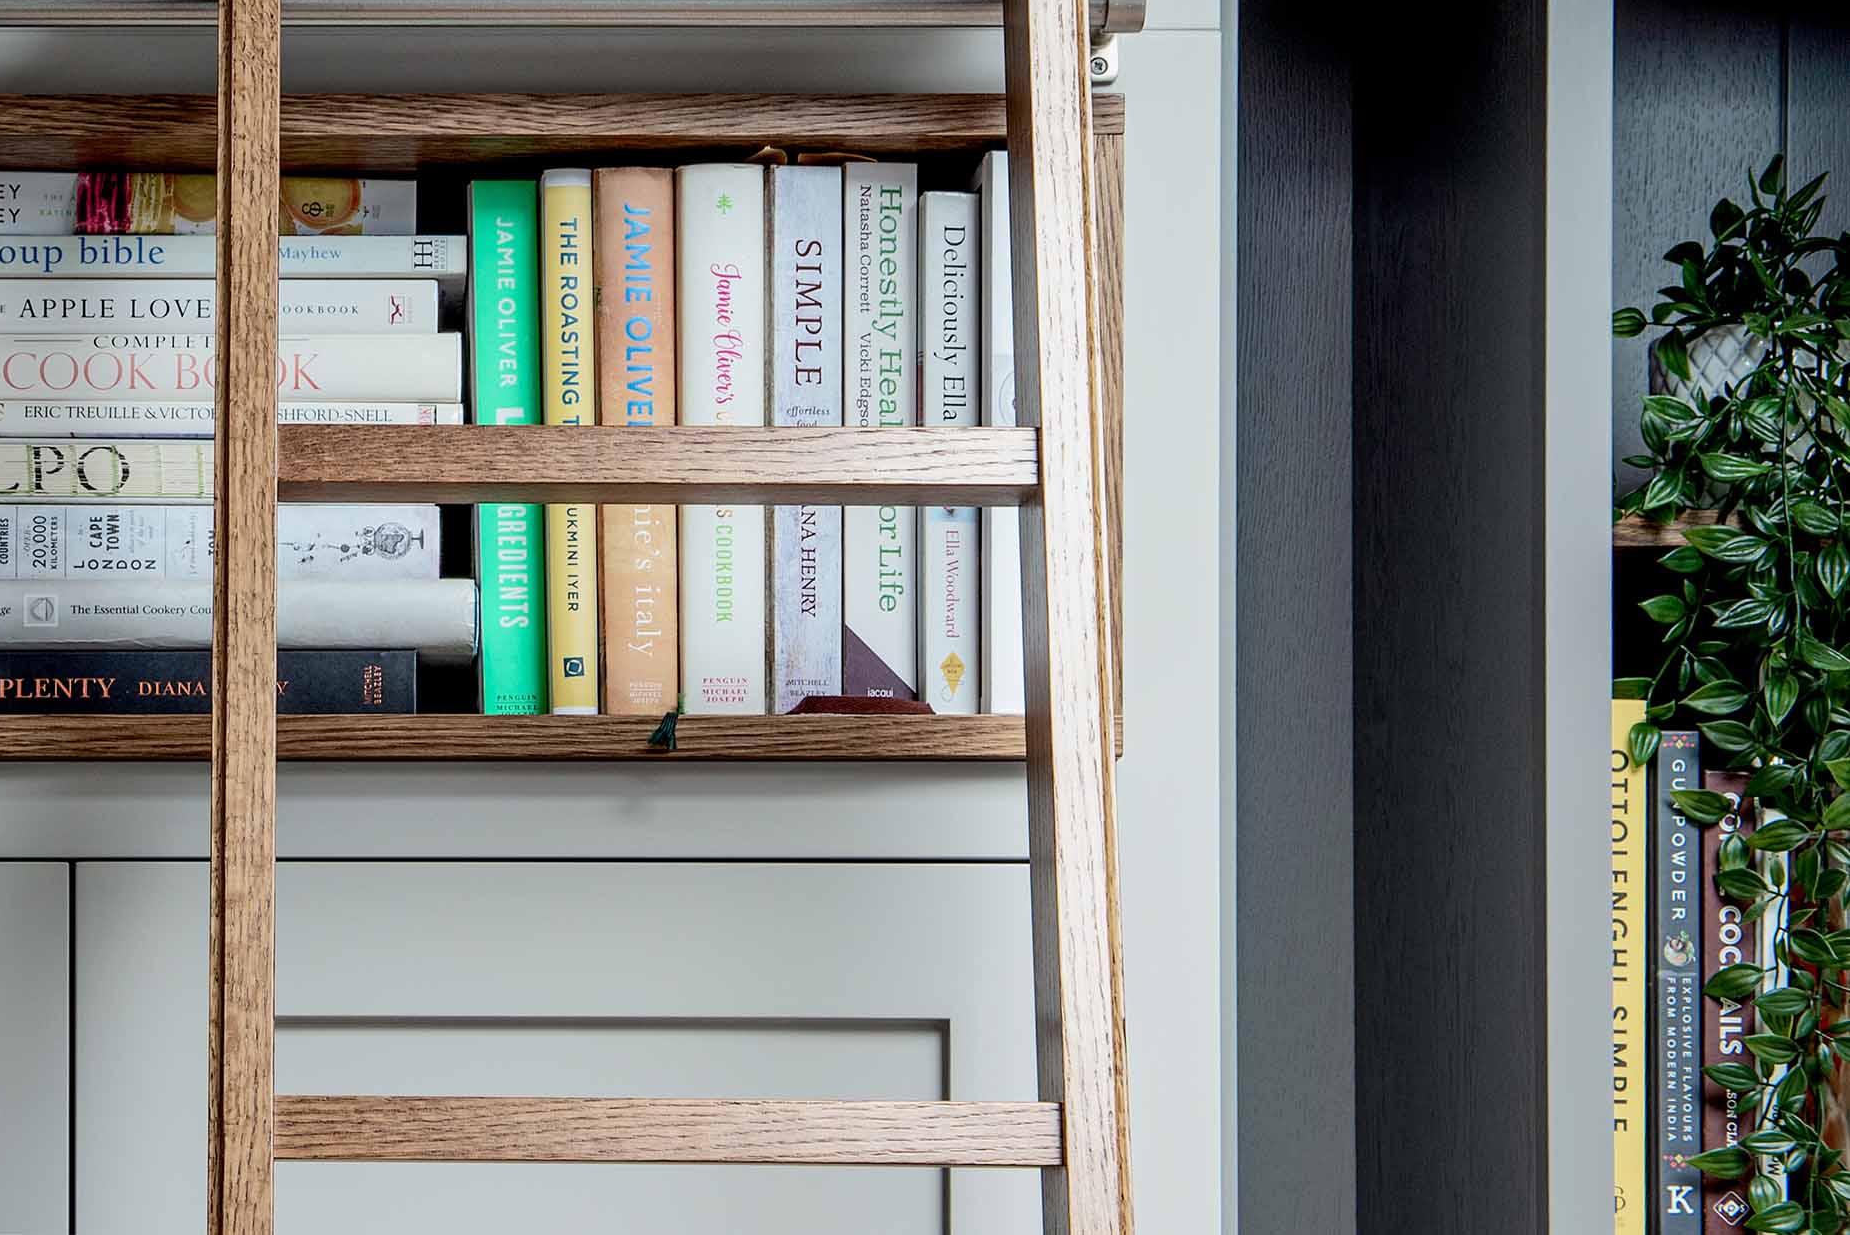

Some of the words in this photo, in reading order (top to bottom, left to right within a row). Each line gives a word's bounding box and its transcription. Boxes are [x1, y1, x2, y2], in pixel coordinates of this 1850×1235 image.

[559, 216, 578, 266] THE
[859, 184, 872, 252] Natasha
[79, 236, 166, 266] bible
[495, 217, 515, 291] JAMIE
[623, 202, 652, 303] JAMIE
[871, 184, 905, 342] Honestly
[709, 262, 743, 327] Jamie
[859, 253, 872, 314] Corrett
[933, 224, 968, 367] Deliciously
[19, 298, 116, 320] APPLE
[130, 298, 212, 320] LOVE
[282, 305, 360, 315] OOKBOOK
[794, 238, 823, 387] SIMPLE
[93, 335, 216, 350] COMPLET
[497, 296, 518, 387] OLIVER
[560, 275, 580, 406] ROASTING
[859, 332, 872, 373] Vicki
[2, 352, 159, 391] COOK
[23, 405, 62, 420] ERIC
[65, 405, 141, 421] TREUILLE
[143, 405, 157, 420] &
[278, 408, 393, 422] SHFORD-SNELL
[786, 404, 831, 417] effortless
[941, 373, 968, 422] Ella
[0, 517, 10, 565] COUNTRIES
[32, 515, 49, 569] 20,000
[50, 516, 58, 570] KILOMETERS
[89, 516, 103, 549] CAPE
[106, 513, 120, 552] TOWN
[945, 529, 961, 556] Ella
[73, 558, 157, 571] LONDON
[497, 505, 530, 629] GREDIENTS
[715, 523, 734, 622] COOKBOOK
[800, 547, 817, 618] HENRY
[878, 544, 905, 613] Life
[70, 605, 90, 615] The
[93, 604, 139, 615] Essential
[142, 604, 186, 617] Cookery
[566, 573, 580, 612] IYER
[945, 557, 961, 639] Woodward
[628, 587, 663, 657] italy
[136, 680, 208, 697] DIANA
[496, 693, 538, 702] PENGUIN
[702, 677, 749, 685] PENGUIN
[702, 688, 749, 696] MICHAEL
[1670, 758, 1687, 921] GUPOWDER
[1667, 976, 1678, 1019] FROM
[1682, 976, 1693, 1059] EXPLOSIVE
[1667, 1026, 1678, 1090] MODERN
[1667, 1098, 1677, 1142] INDIA
[1682, 1065, 1694, 1143] FLAVOURS
[1666, 1185, 1695, 1215] K
